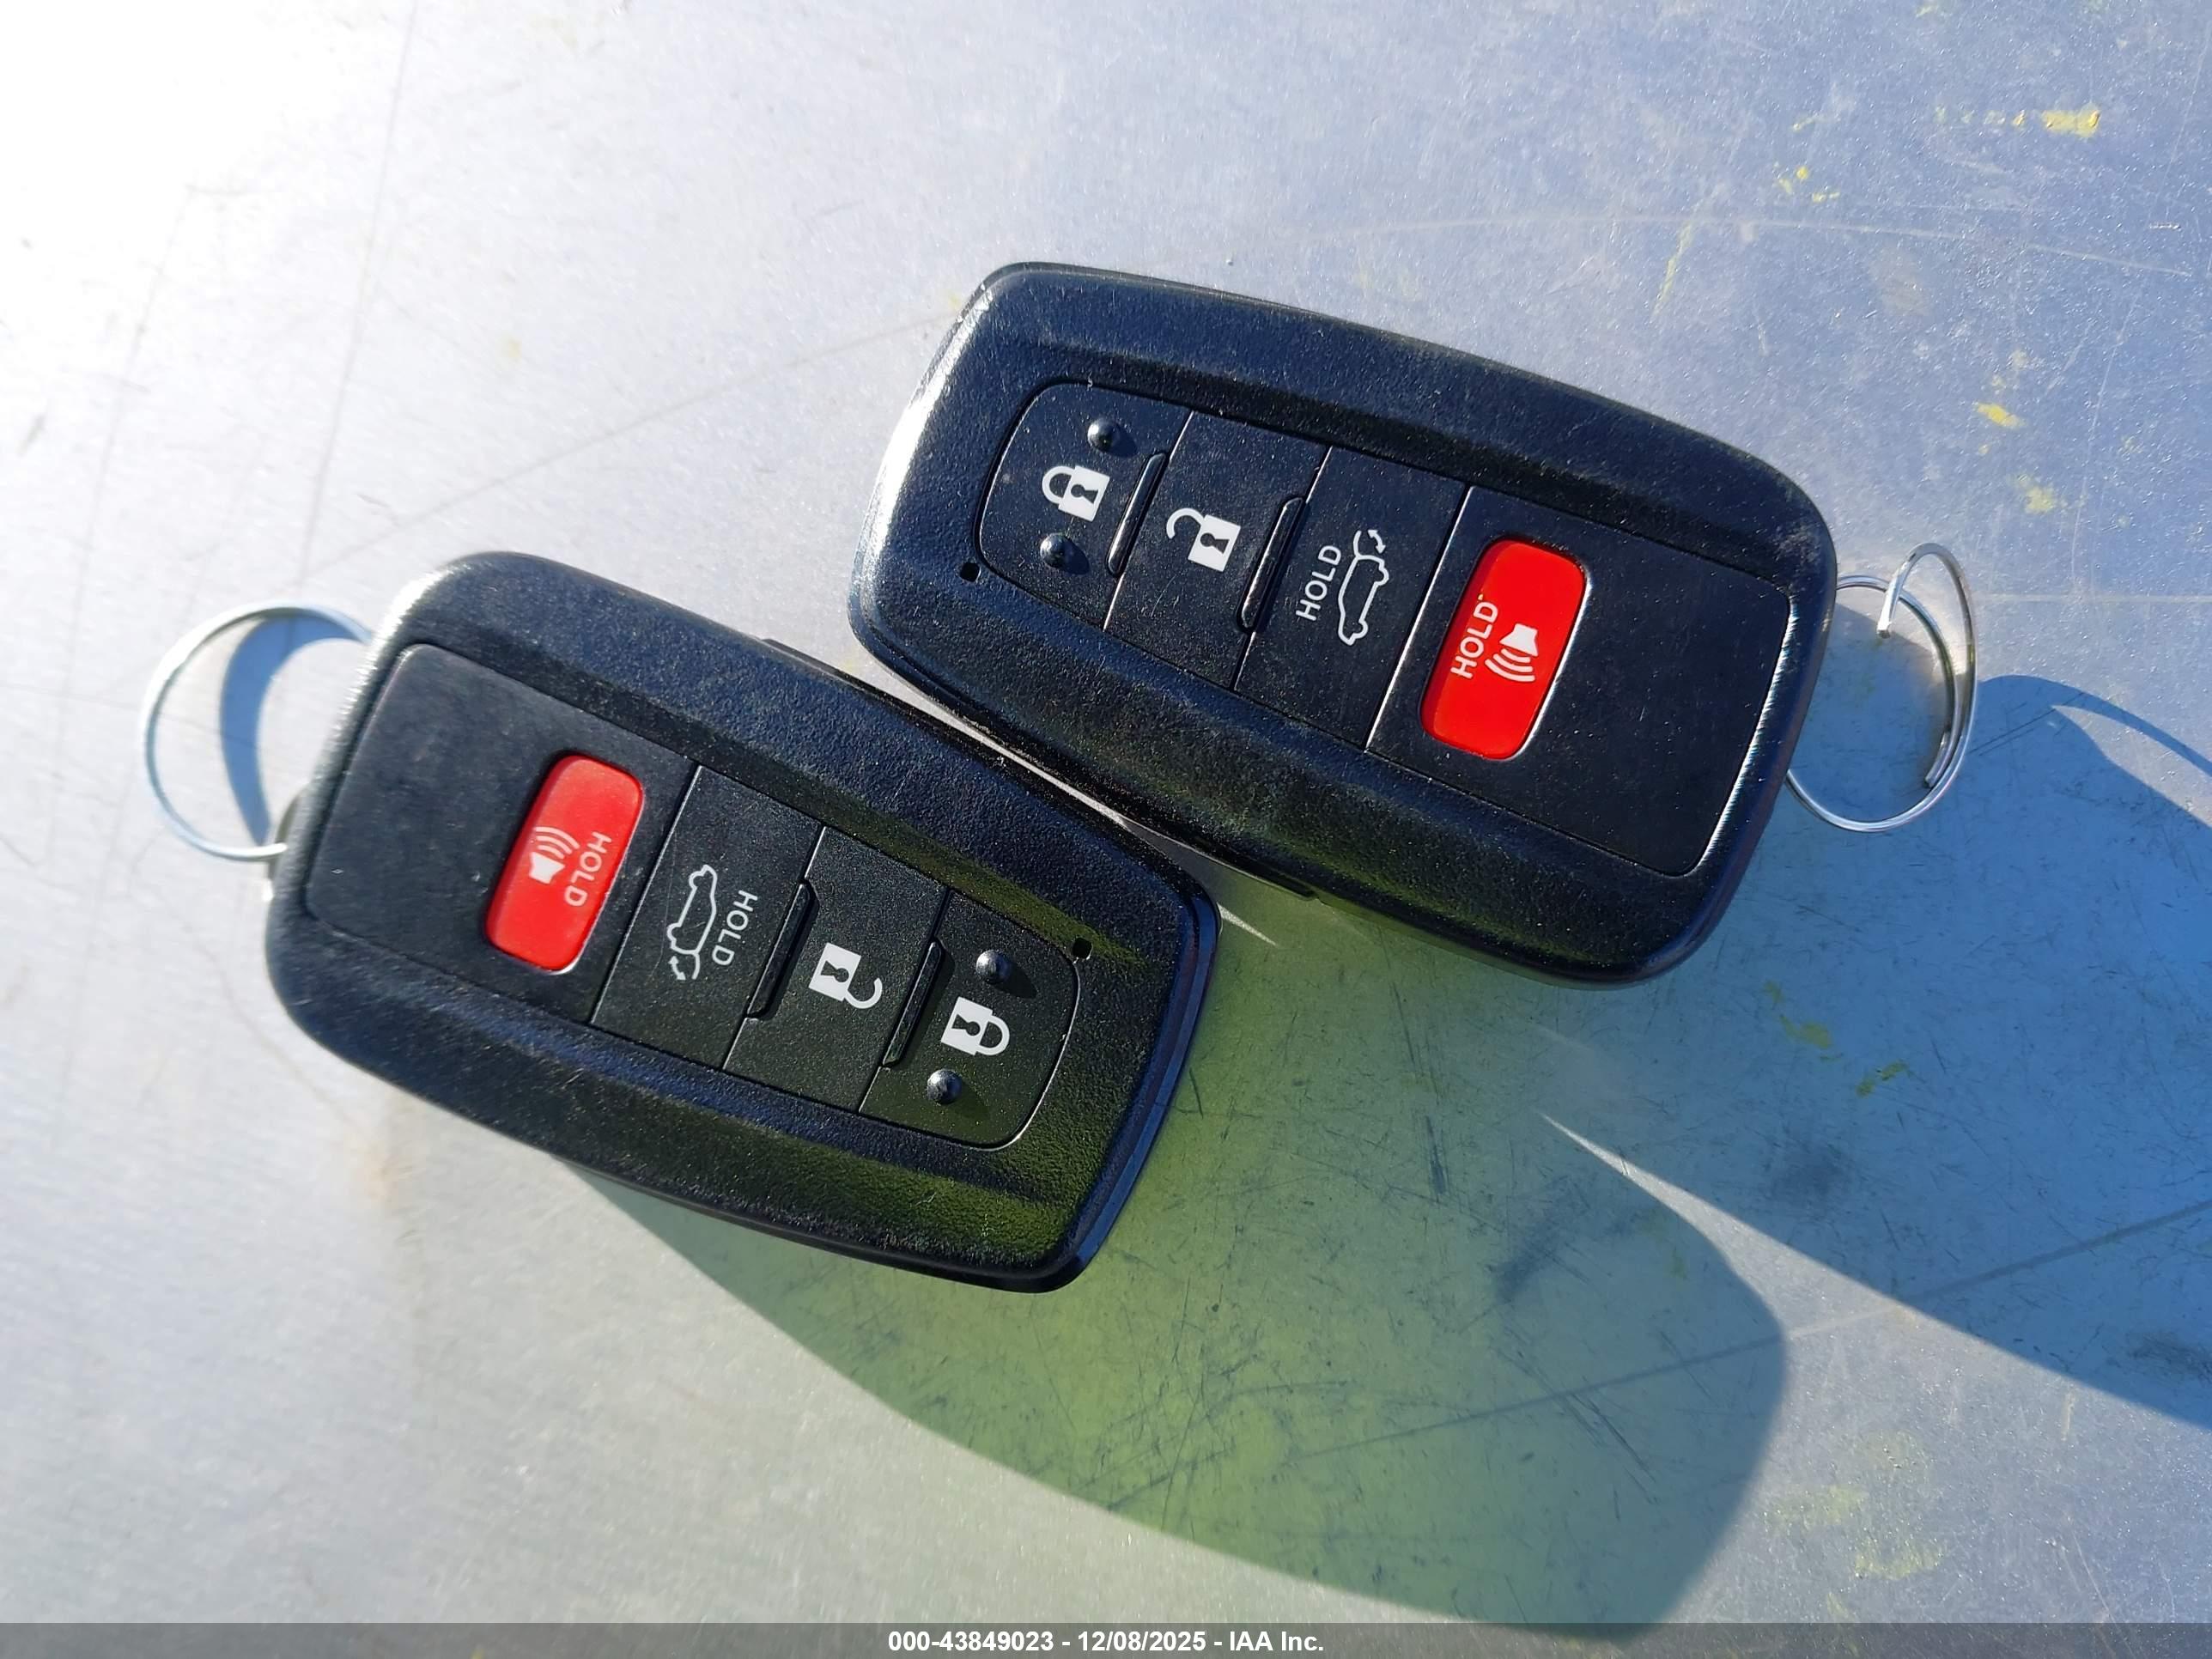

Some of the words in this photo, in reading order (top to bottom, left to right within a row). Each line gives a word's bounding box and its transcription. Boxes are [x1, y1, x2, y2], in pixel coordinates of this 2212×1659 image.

[1296, 545, 1341, 621] HOLD
[1450, 601, 1498, 679] HOLD
[564, 831, 612, 907] HOLD
[712, 890, 759, 966] HOLD
